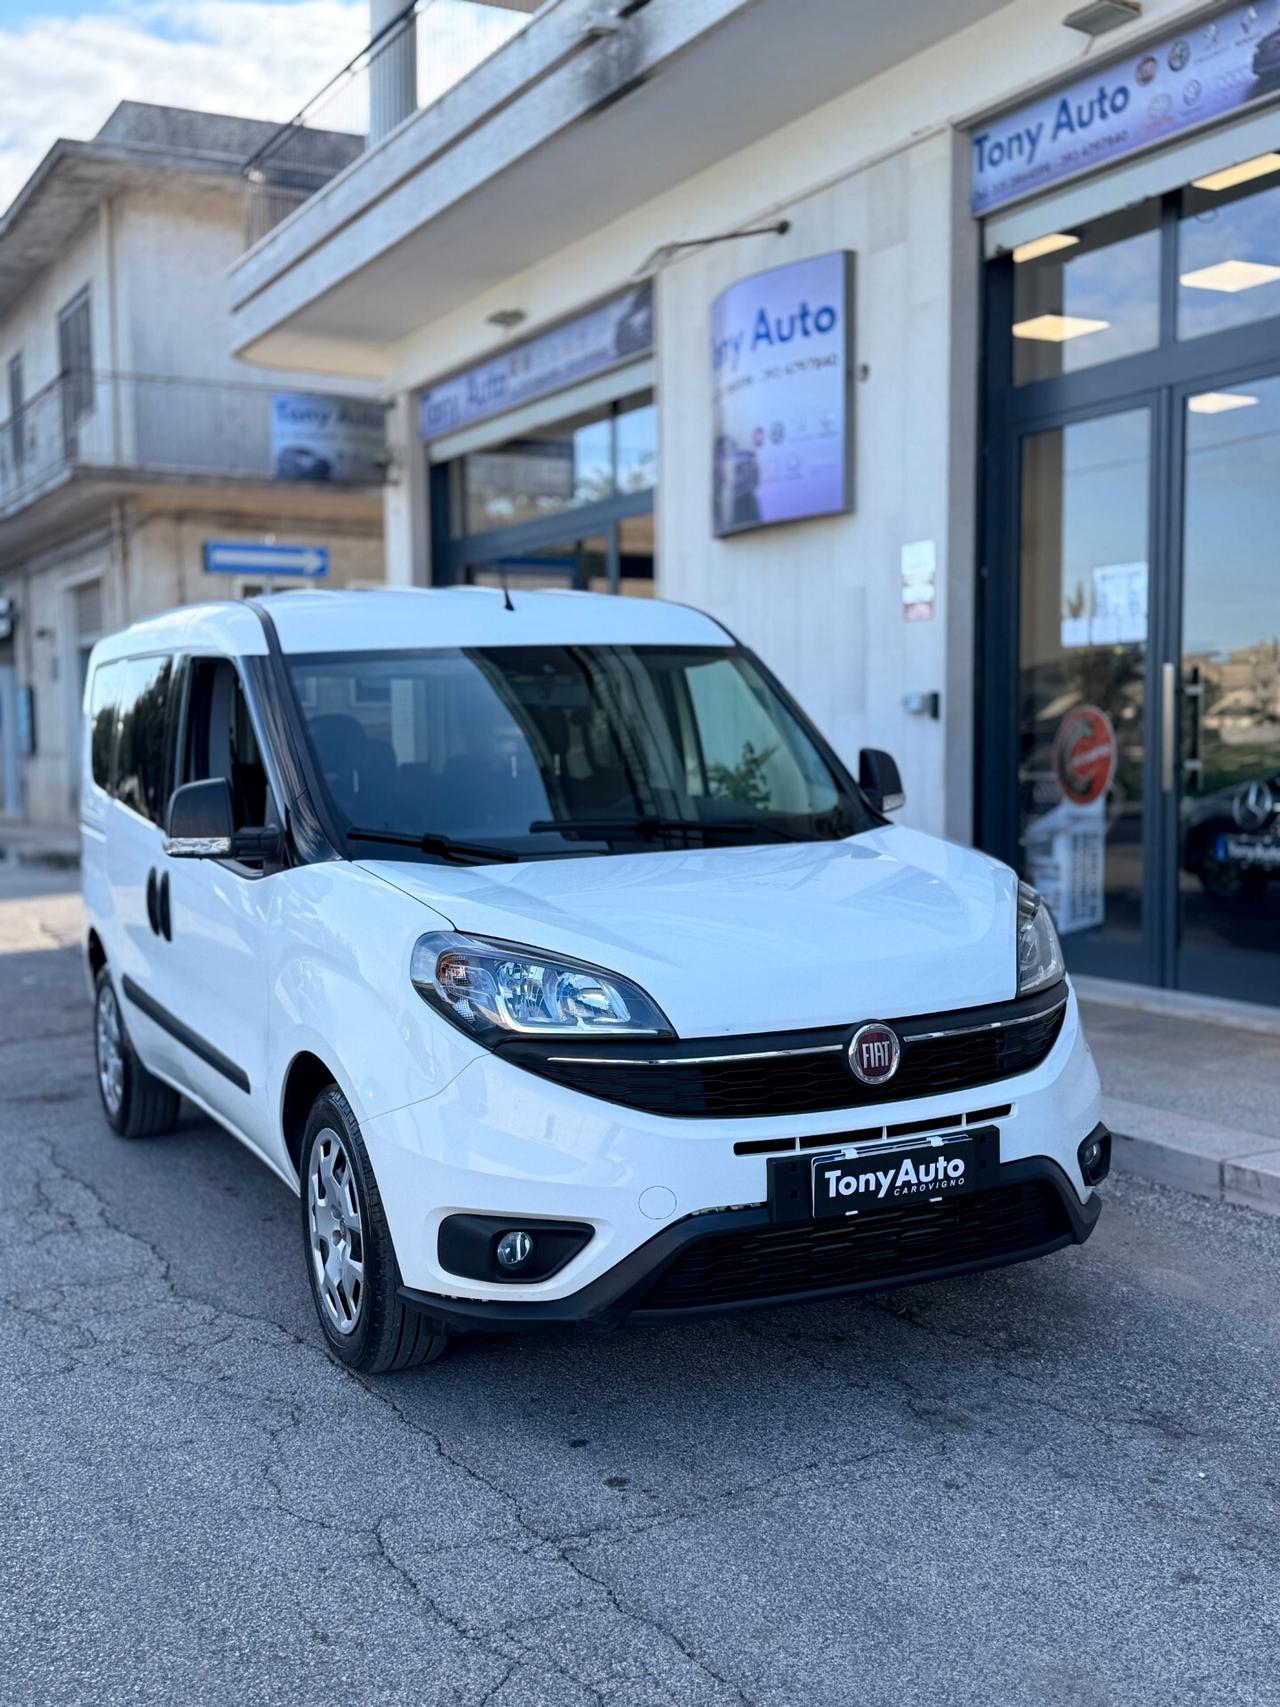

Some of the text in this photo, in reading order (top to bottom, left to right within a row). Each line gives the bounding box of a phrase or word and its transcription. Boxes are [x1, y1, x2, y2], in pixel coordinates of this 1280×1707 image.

[973, 122, 1043, 174] Tony
[1051, 85, 1131, 141] Auto
[750, 301, 836, 351] Auto
[862, 1041, 890, 1068] FIAT
[825, 1156, 965, 1198] TonyAuto
[894, 1178, 965, 1196] CAROVIGNO
